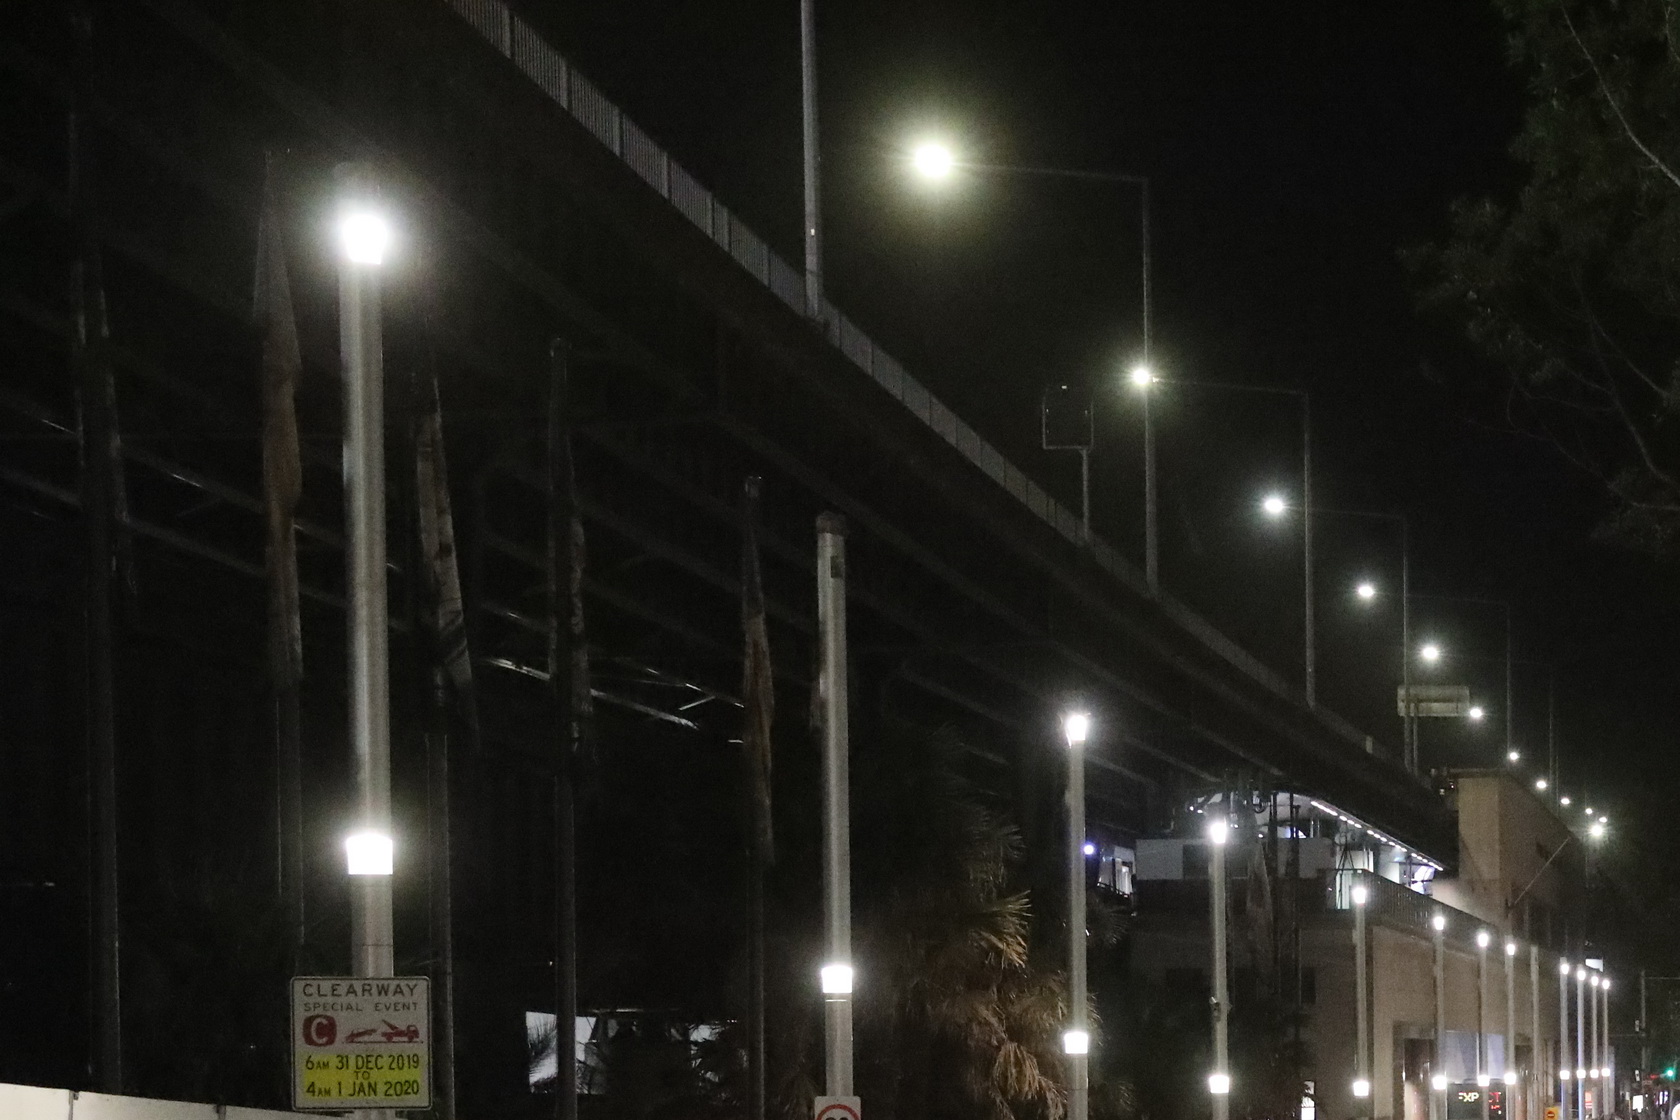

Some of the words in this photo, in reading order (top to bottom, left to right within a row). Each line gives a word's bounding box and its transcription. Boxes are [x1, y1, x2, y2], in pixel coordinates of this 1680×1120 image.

[302, 983, 418, 997] CLEARWAY
[303, 1002, 363, 1012] SPECIAL
[375, 1002, 419, 1012] EVENT
[310, 1018, 328, 1043] C
[305, 1054, 330, 1071] 6AM
[336, 1054, 350, 1070] 31
[355, 1054, 384, 1070] DEC
[388, 1053, 420, 1070] 2019
[354, 1071, 371, 1080] TO
[306, 1081, 332, 1097] 4AM
[338, 1082, 342, 1097] 1
[348, 1081, 378, 1097] JAN
[384, 1080, 420, 1097] 2020
